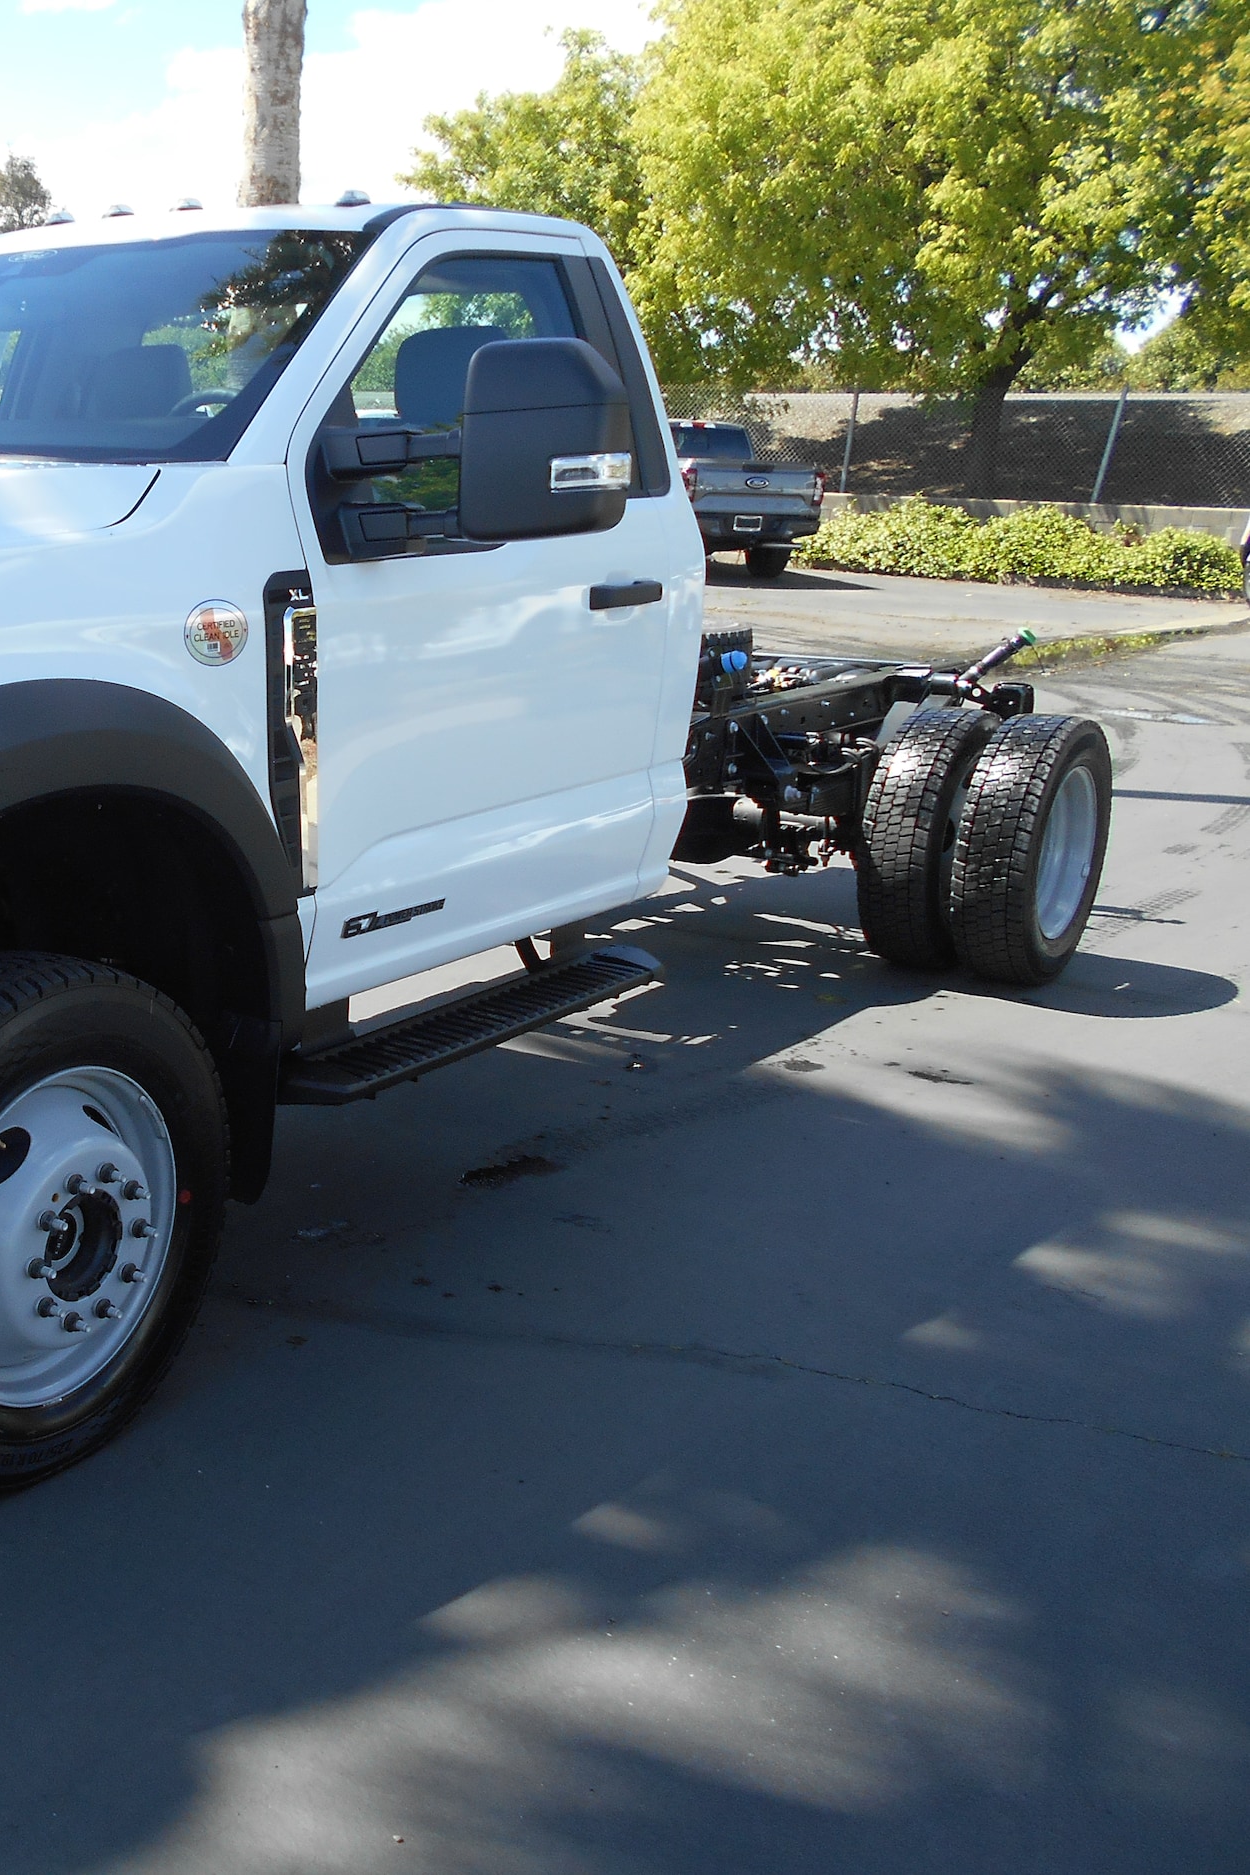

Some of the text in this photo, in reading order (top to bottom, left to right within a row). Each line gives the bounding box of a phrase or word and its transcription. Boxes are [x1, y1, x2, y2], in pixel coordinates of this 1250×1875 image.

[288, 588, 309, 601] XL
[197, 619, 236, 631] CERTIFIED
[193, 632, 220, 643] CLEAN
